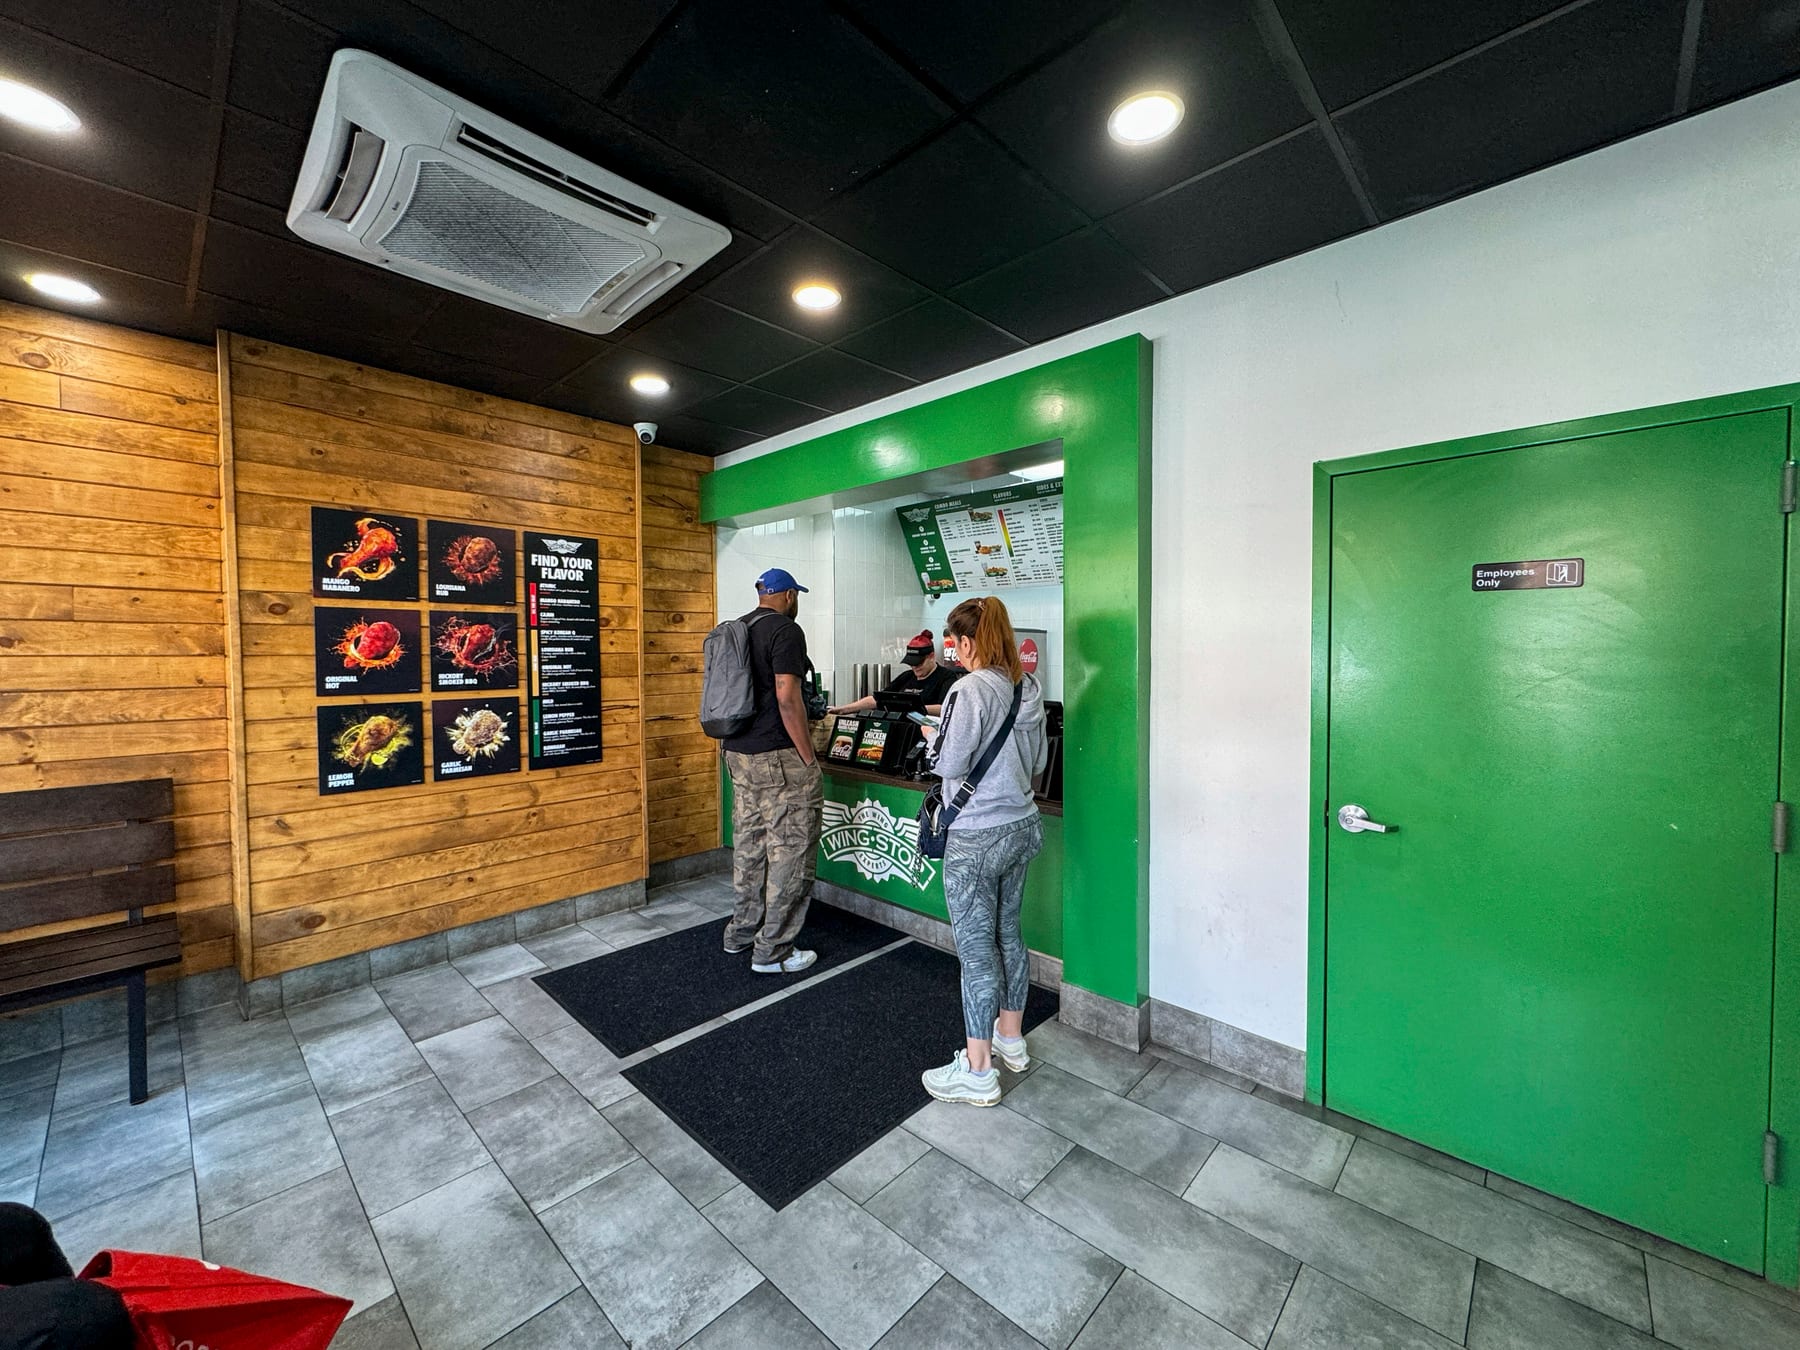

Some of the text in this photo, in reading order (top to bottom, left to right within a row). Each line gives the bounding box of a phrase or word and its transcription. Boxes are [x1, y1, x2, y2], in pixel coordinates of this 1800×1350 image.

[531, 554, 593, 570] FIND YOUR
[541, 567, 584, 581] FLAVOR
[1476, 568, 1536, 579] Employees
[322, 577, 350, 586] MANGO
[1476, 579, 1500, 588] Only
[322, 585, 361, 593] HABANERO
[436, 584, 466, 592] LOUISIANA
[325, 682, 340, 690] HOT
[441, 765, 472, 774] PARMESAN
[328, 773, 353, 781] LEMON
[328, 779, 354, 788] PEPPER
[872, 811, 889, 829] WING
